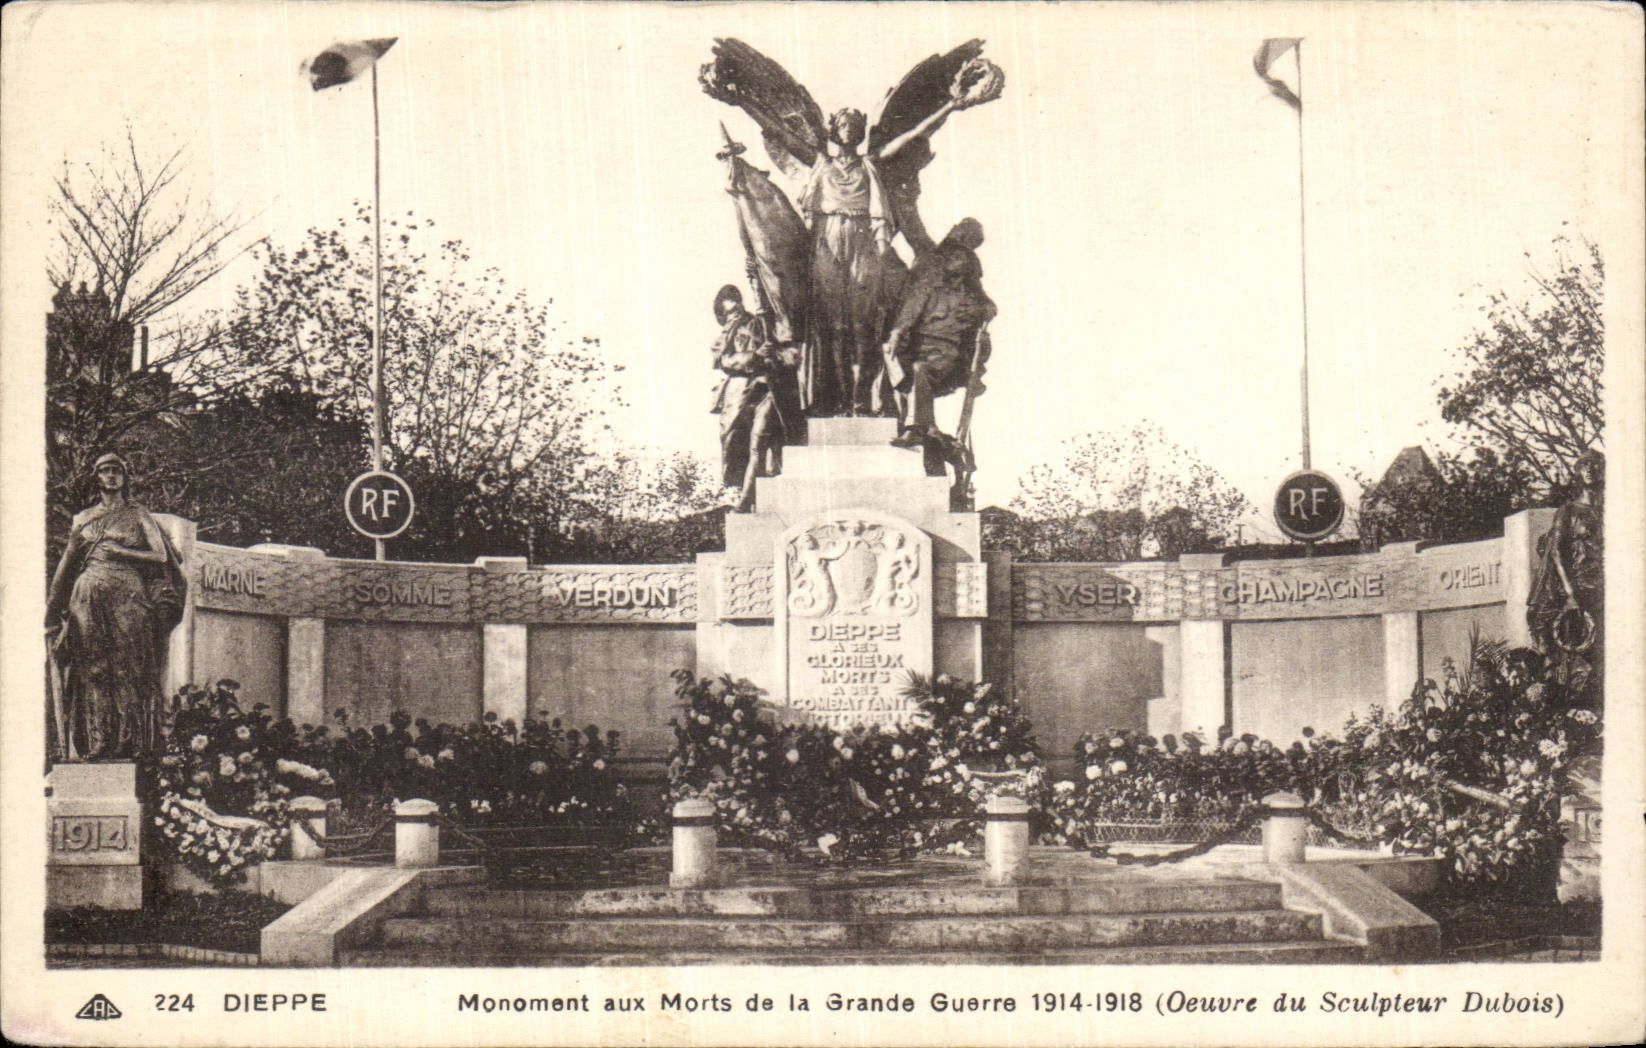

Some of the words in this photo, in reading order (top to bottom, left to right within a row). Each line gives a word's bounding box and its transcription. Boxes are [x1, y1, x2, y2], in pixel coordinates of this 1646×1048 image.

[361, 487, 400, 521] RF
[1288, 487, 1328, 521] RF
[202, 563, 266, 598] MARNE
[1439, 561, 1502, 590] ORIENT
[355, 580, 452, 608] SOMME
[557, 584, 675, 609] VERDUN
[1056, 582, 1140, 606] YSER
[1222, 572, 1384, 606] CHAMPAGNE
[809, 622, 902, 642] DIEPPE
[832, 642, 847, 653] A
[806, 653, 905, 669] GLORIEUX
[820, 669, 891, 684] MORTS
[832, 685, 847, 696] A
[55, 819, 128, 852] 1914
